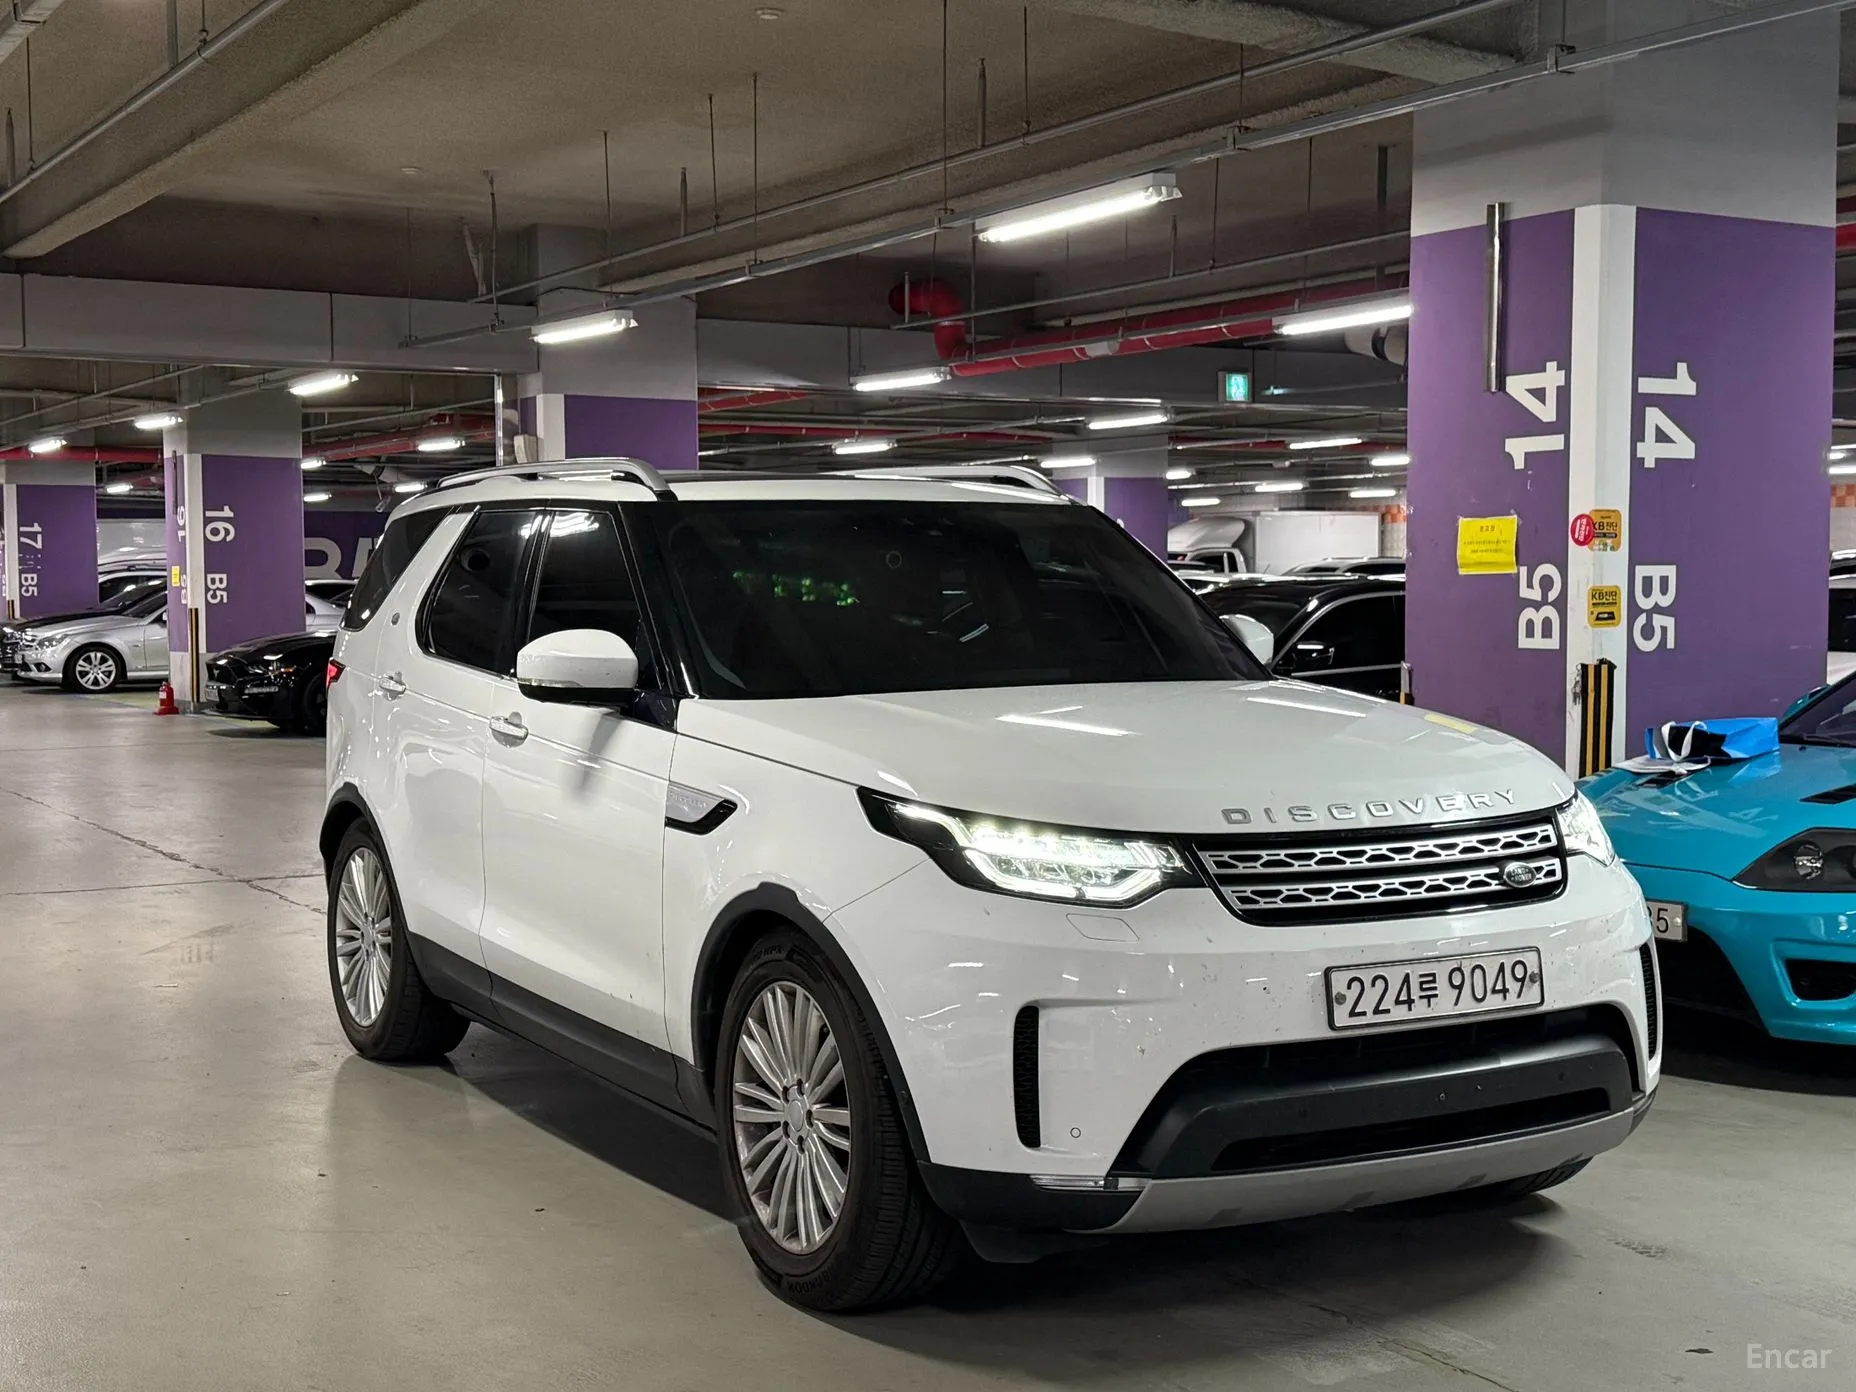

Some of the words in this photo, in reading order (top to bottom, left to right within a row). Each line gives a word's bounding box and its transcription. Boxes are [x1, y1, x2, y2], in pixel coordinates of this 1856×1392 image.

[1505, 361, 1565, 470] 14
[1636, 362, 1696, 468] 14
[19, 522, 42, 549] 17
[205, 505, 235, 542] 16
[21, 573, 38, 597] B5
[206, 573, 228, 604] B5
[1518, 563, 1562, 650] B5
[1632, 565, 1676, 652] B5
[1221, 789, 1516, 824] DISCOVERY
[1346, 971, 1439, 1018] 224루
[1448, 959, 1528, 1006] 9049
